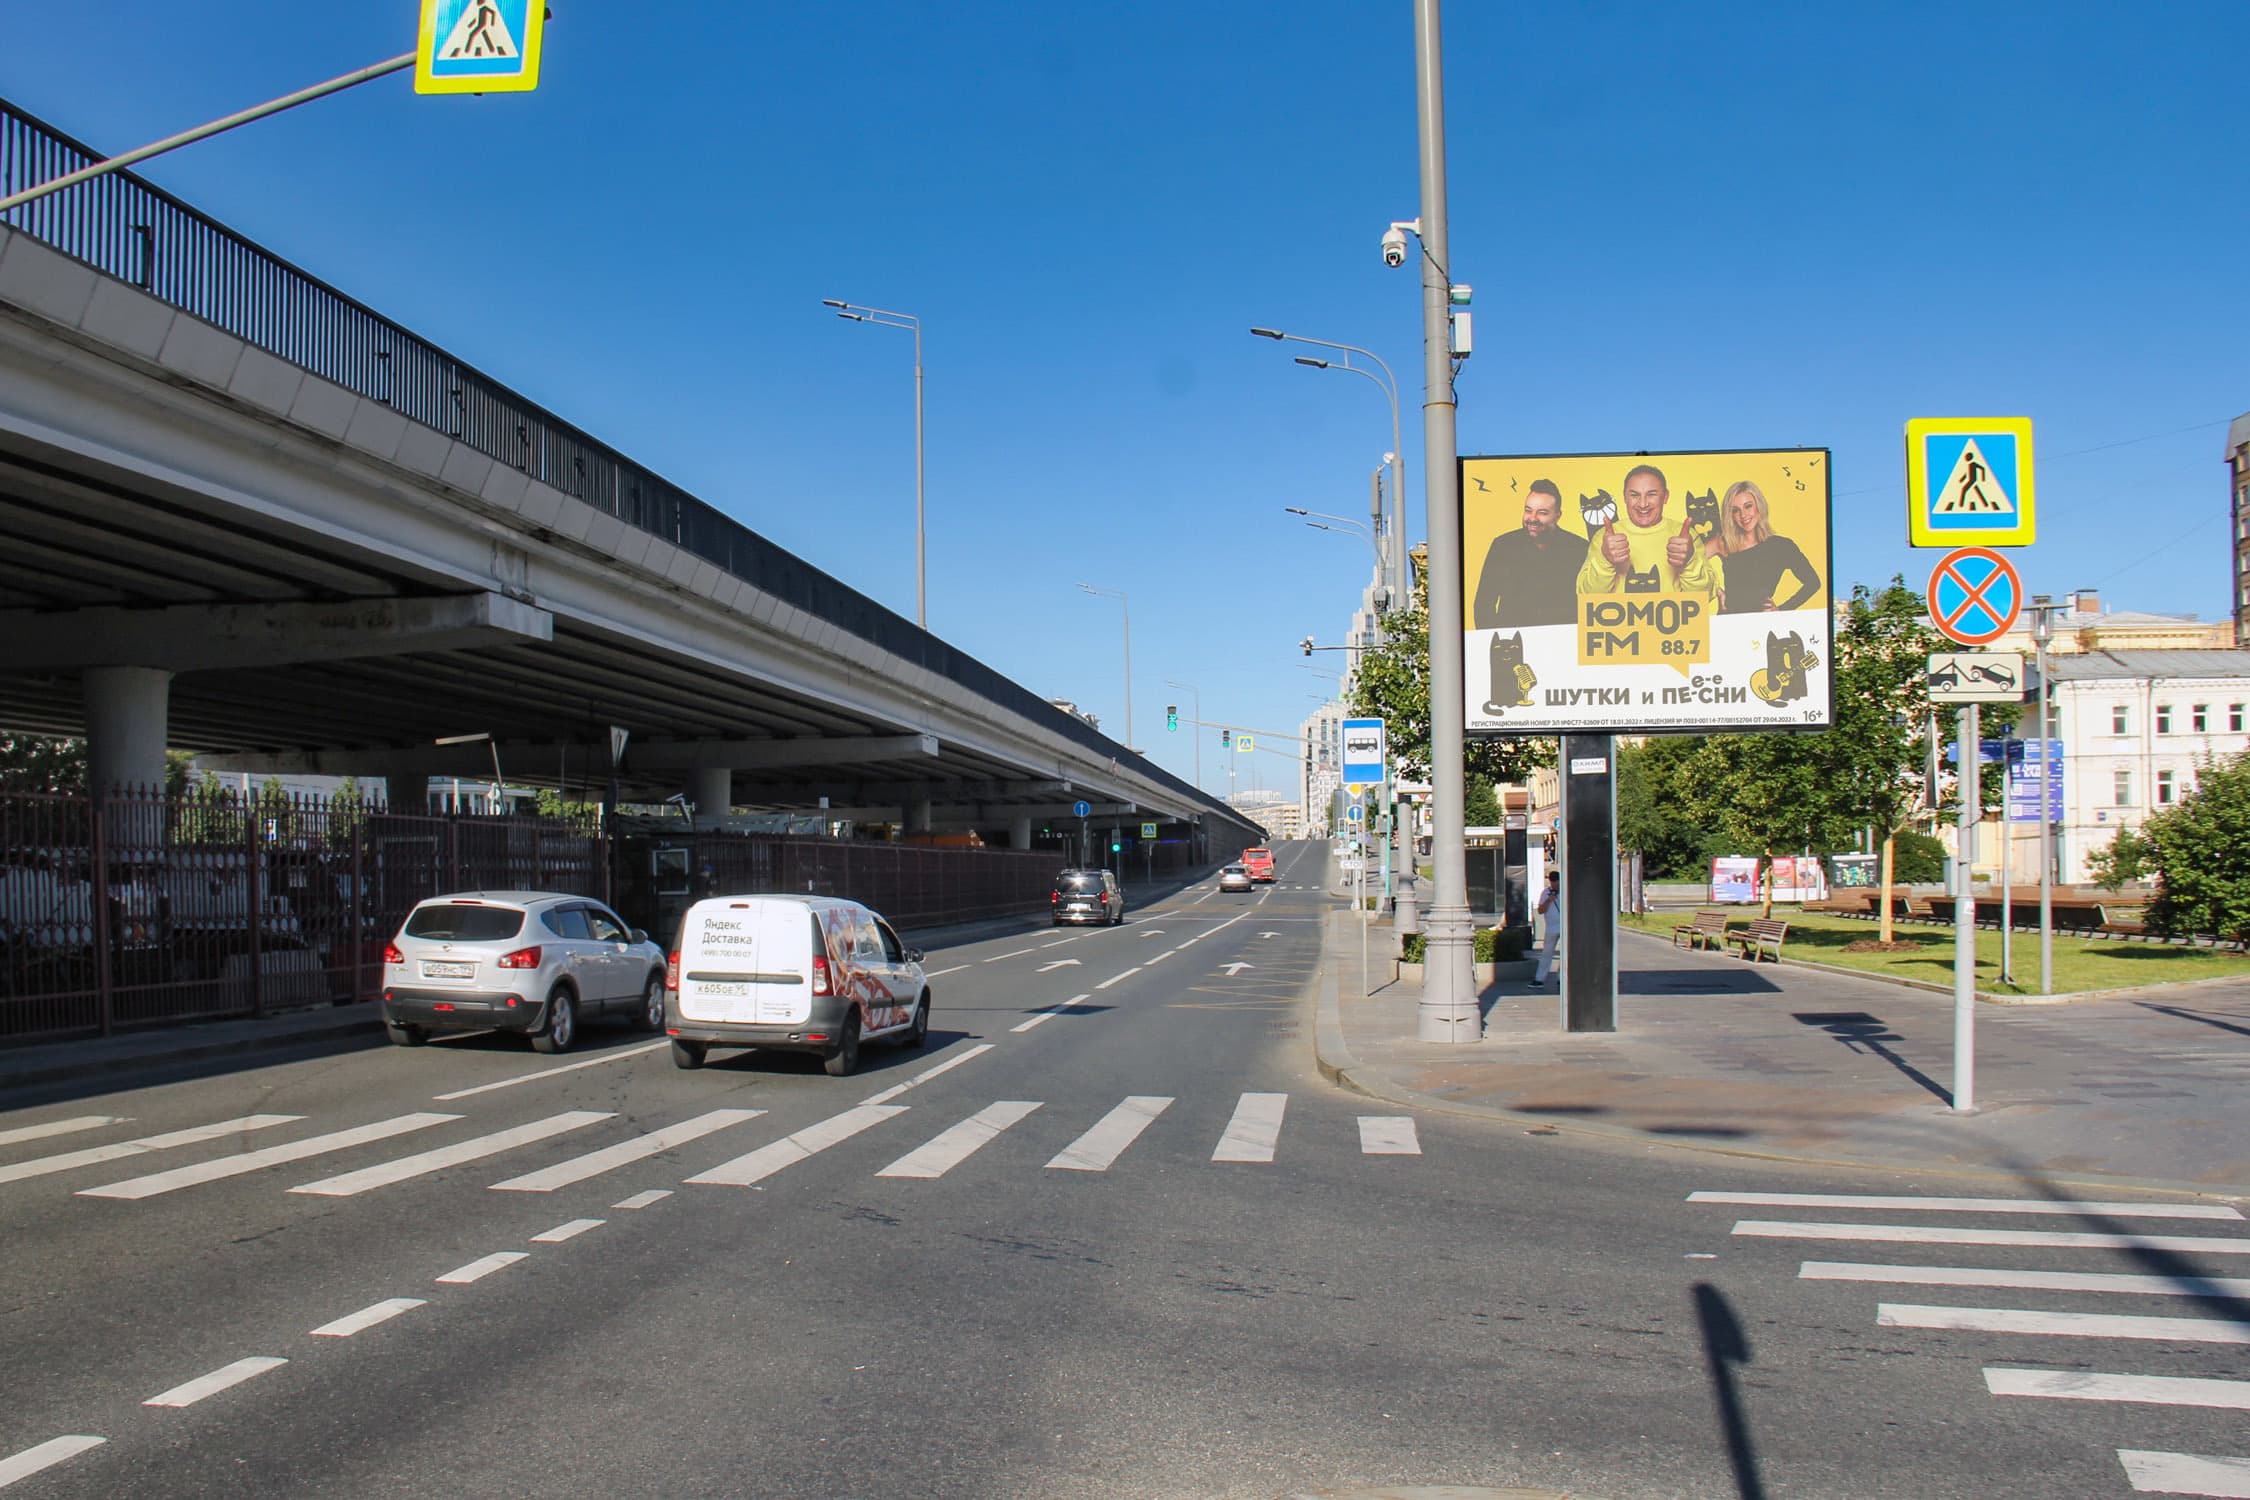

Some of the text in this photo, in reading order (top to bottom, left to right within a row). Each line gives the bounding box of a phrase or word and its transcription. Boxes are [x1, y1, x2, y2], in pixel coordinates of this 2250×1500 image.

[1586, 600, 1700, 634] ЮМОР
[1586, 631, 1700, 656] FM 88.7
[1545, 688, 1630, 706] ШУТКИ
[1642, 691, 1653, 704] и
[1803, 710, 1823, 722] 16+
[704, 919, 742, 930] Яндекс
[702, 932, 753, 945] Доставка
